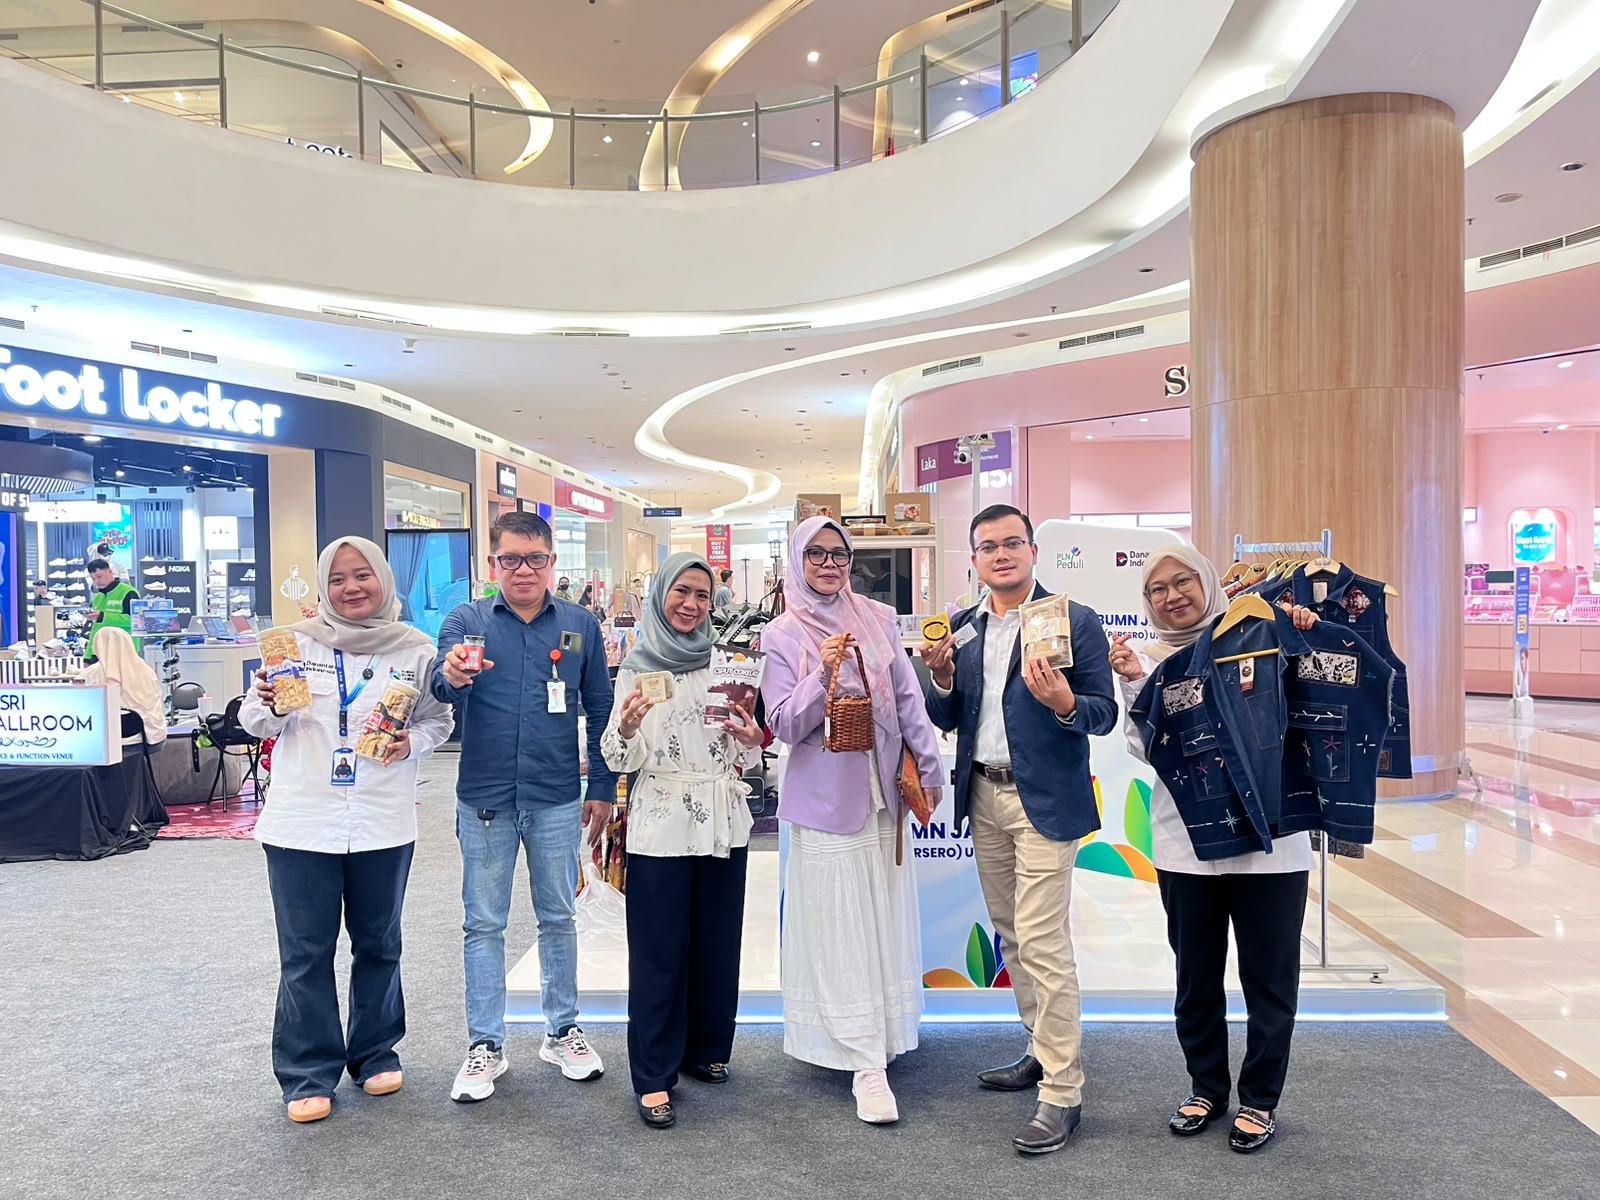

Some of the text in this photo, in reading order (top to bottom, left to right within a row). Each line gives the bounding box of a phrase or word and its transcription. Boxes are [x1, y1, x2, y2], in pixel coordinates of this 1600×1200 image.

[1164, 366, 1190, 397] S
[121, 367, 281, 437] Locker
[921, 457, 937, 471] Laka
[1057, 553, 1070, 561] PLN
[1057, 559, 1084, 569] Peduli
[168, 565, 191, 573] HOKA
[0, 695, 25, 710] SRI
